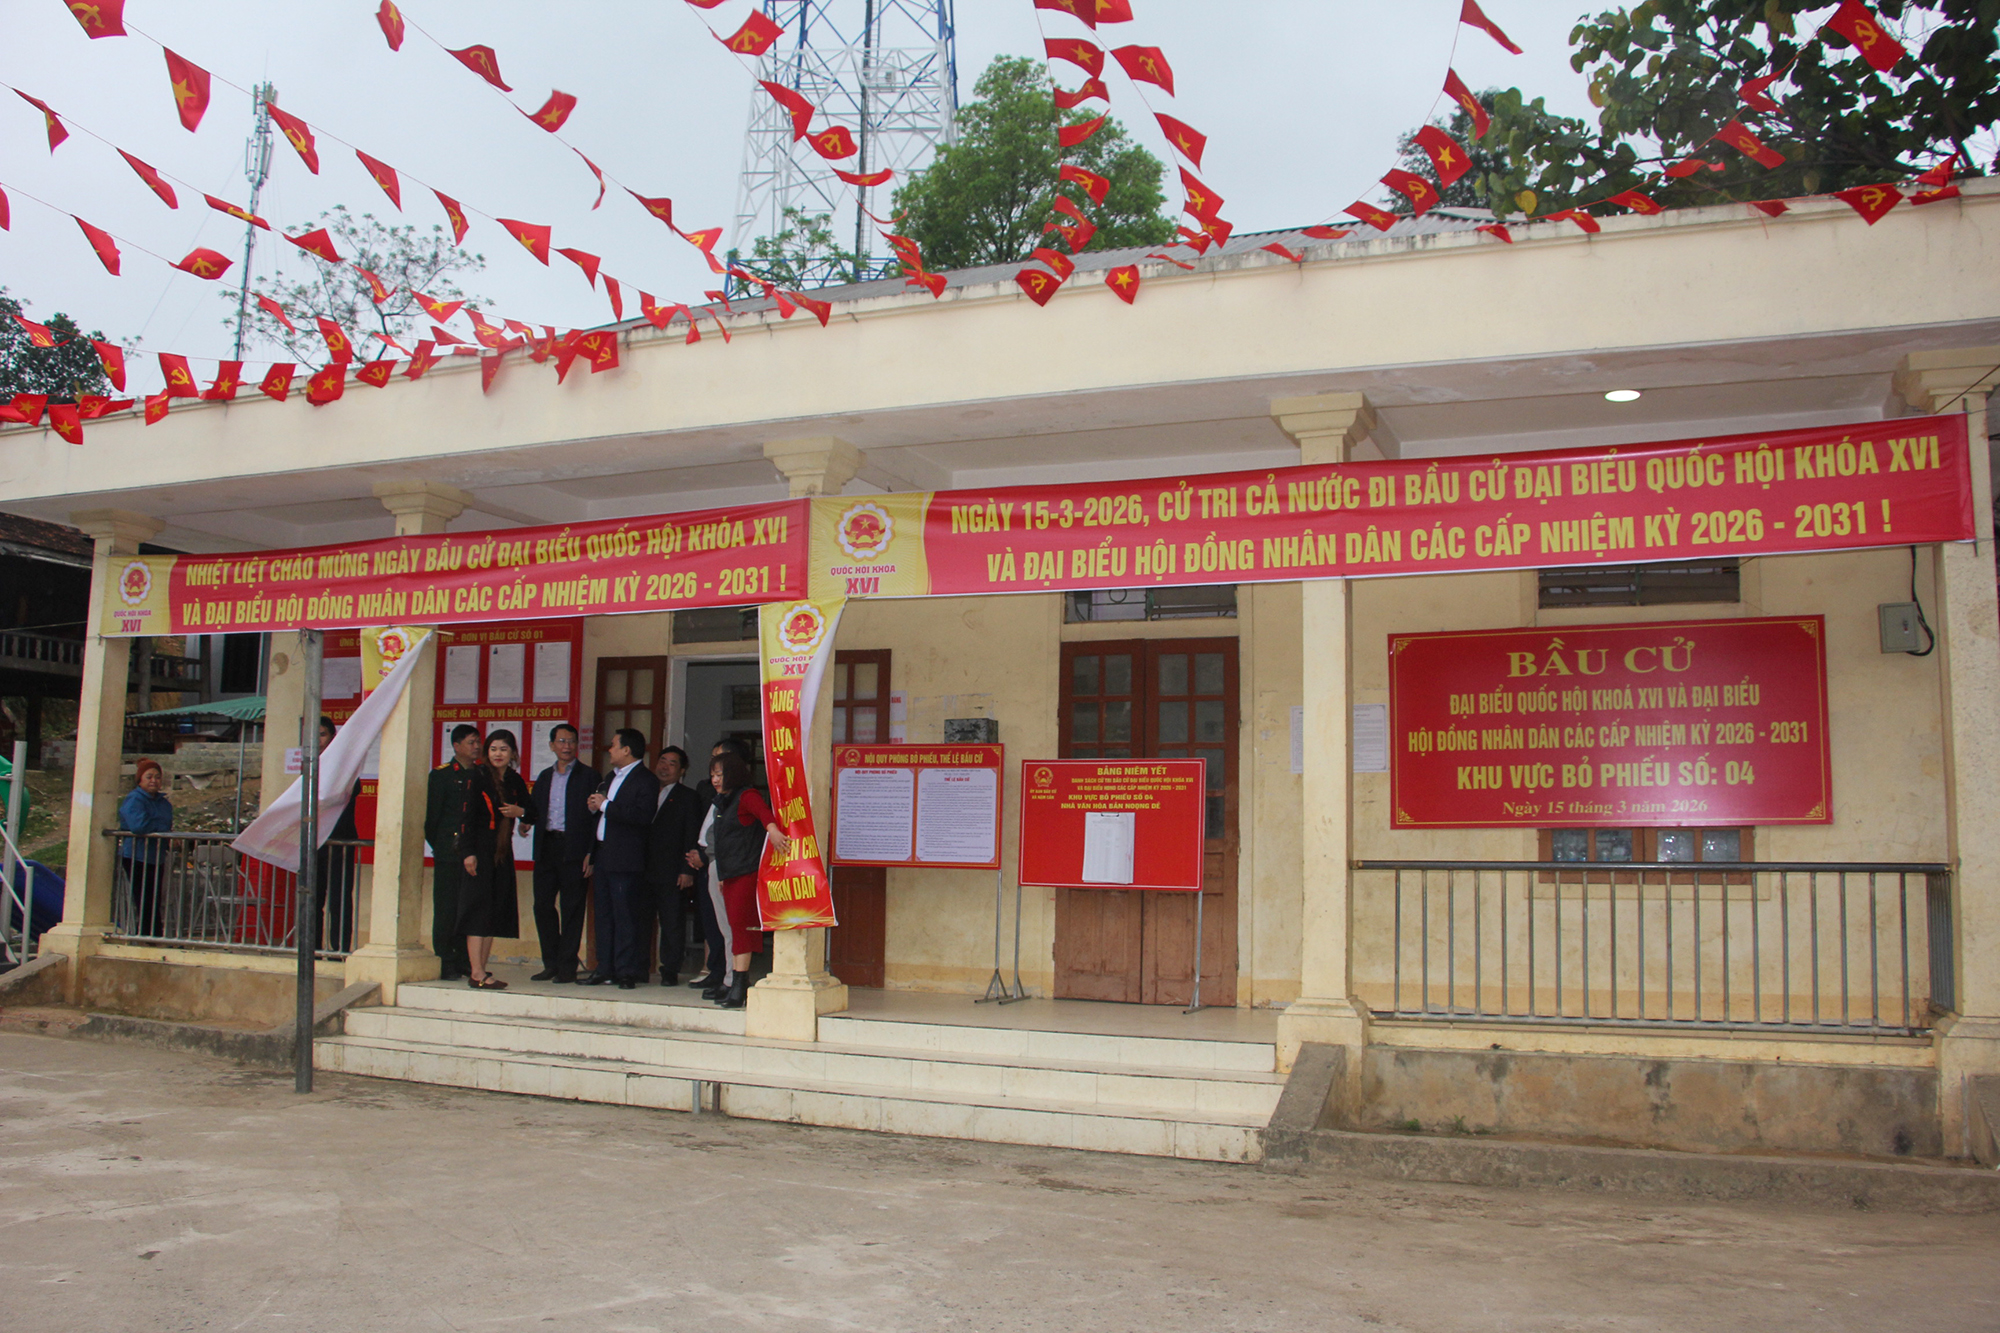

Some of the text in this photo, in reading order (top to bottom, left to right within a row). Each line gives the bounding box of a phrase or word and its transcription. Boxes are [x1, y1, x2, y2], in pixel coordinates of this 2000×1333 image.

[951, 435, 1940, 534] NGÀY 15-3-2026, CỬ TRI CẢ NƯỚC ĐI BẦU CỬ ĐẠI BIỂU QUỐC HỘI KHÓA XVI
[185, 515, 788, 590] NHIỆT LIỆT CHÀO MỪNG NGÀY BẦU CỬ ĐẠI BIỂU QUỐC HỘI KHÓA XVI
[987, 498, 1892, 586] VÀ ĐẠI BIỂU HỘI ĐỒNG NHÂN DÂN CÁC CẤP NHIỆM KỲ 2026 - 2031 !
[182, 598, 201, 626] VÀ
[205, 601, 232, 629] ĐẠI
[235, 590, 272, 624] BIỂU
[275, 593, 303, 627] HỘI
[306, 588, 353, 621] ĐỒNG
[356, 587, 407, 618] NHÂN
[411, 585, 450, 615] DÂN
[454, 582, 493, 613] CÁC
[497, 574, 537, 611] CẤP
[541, 573, 608, 612] NHIỆM
[613, 570, 641, 603] KỲ
[645, 572, 698, 601] 2026
[717, 565, 769, 596] 2031
[779, 564, 787, 592] !
[845, 577, 880, 594] XVI
[121, 619, 142, 632] XVI
[783, 662, 809, 676] XV
[1506, 636, 1696, 678] BẦU CỬ
[1450, 675, 1760, 719] ĐẠI BIỂU QUỐC HỘI KHOÁ XVI VÀ ĐẠI BIỂU
[771, 726, 794, 757] LỰA
[1408, 727, 1433, 757] HỘI
[1437, 723, 1478, 752] ĐỒNG
[1481, 724, 1524, 750] NHÂN
[1528, 723, 1560, 749] DÂN
[1564, 722, 1595, 749] CÁC
[1599, 718, 1630, 747] CẤP
[1635, 720, 1686, 751] NHIỆM
[1691, 719, 1711, 745] KỲ
[1715, 722, 1755, 745] 2026
[1770, 721, 1808, 743] 2031
[1097, 765, 1167, 775] BẢNG NIÊM YẾT
[1457, 752, 1755, 794] KHU VỰC BỎ PHIẾU SỐ: 04
[1502, 799, 1708, 817] Ngày 15 tháng 3 năm 2026
[792, 871, 817, 900] DÂN
